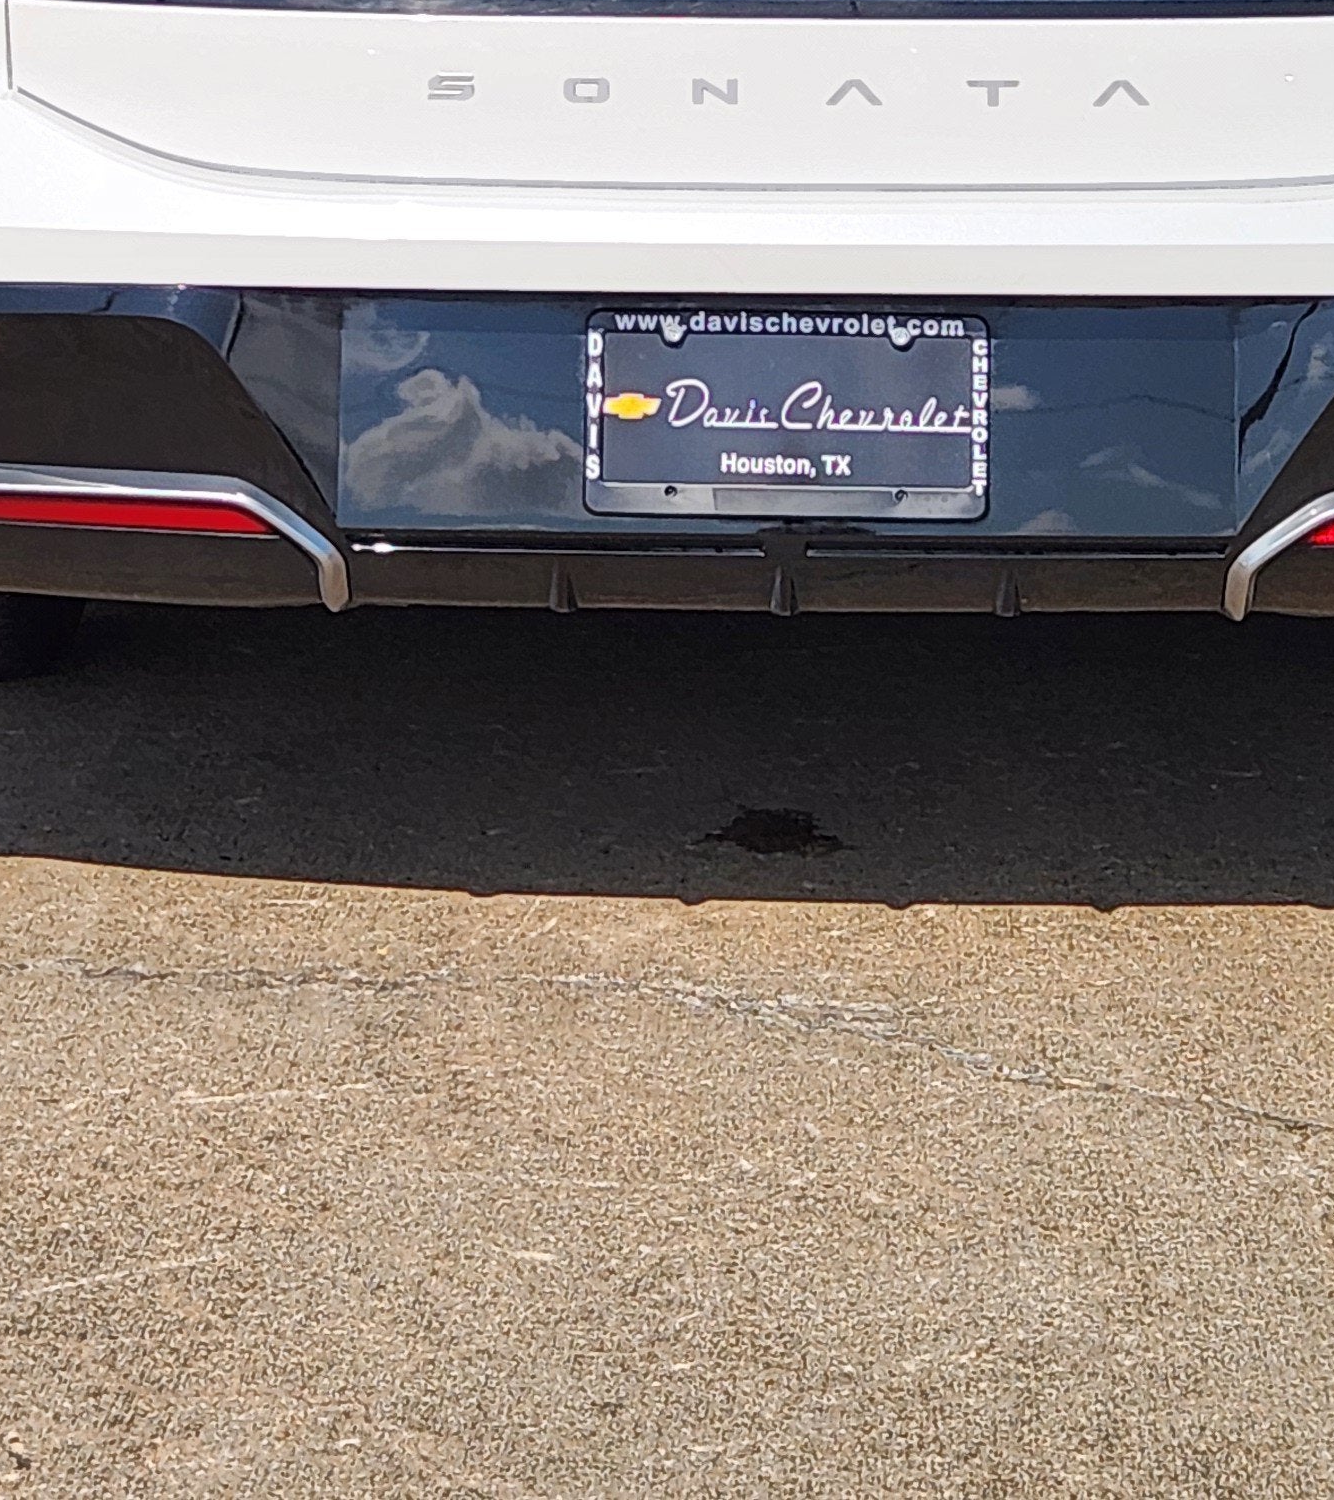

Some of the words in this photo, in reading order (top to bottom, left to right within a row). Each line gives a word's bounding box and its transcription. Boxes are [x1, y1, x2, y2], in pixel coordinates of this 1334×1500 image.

[426, 72, 1151, 108] SONATA
[585, 331, 604, 480] DAVIS
[666, 378, 778, 429] Davis
[780, 380, 972, 433] Chevrolet
[971, 338, 989, 497] CHEVROLET
[720, 452, 816, 478] Houston,
[821, 454, 851, 476] TX
